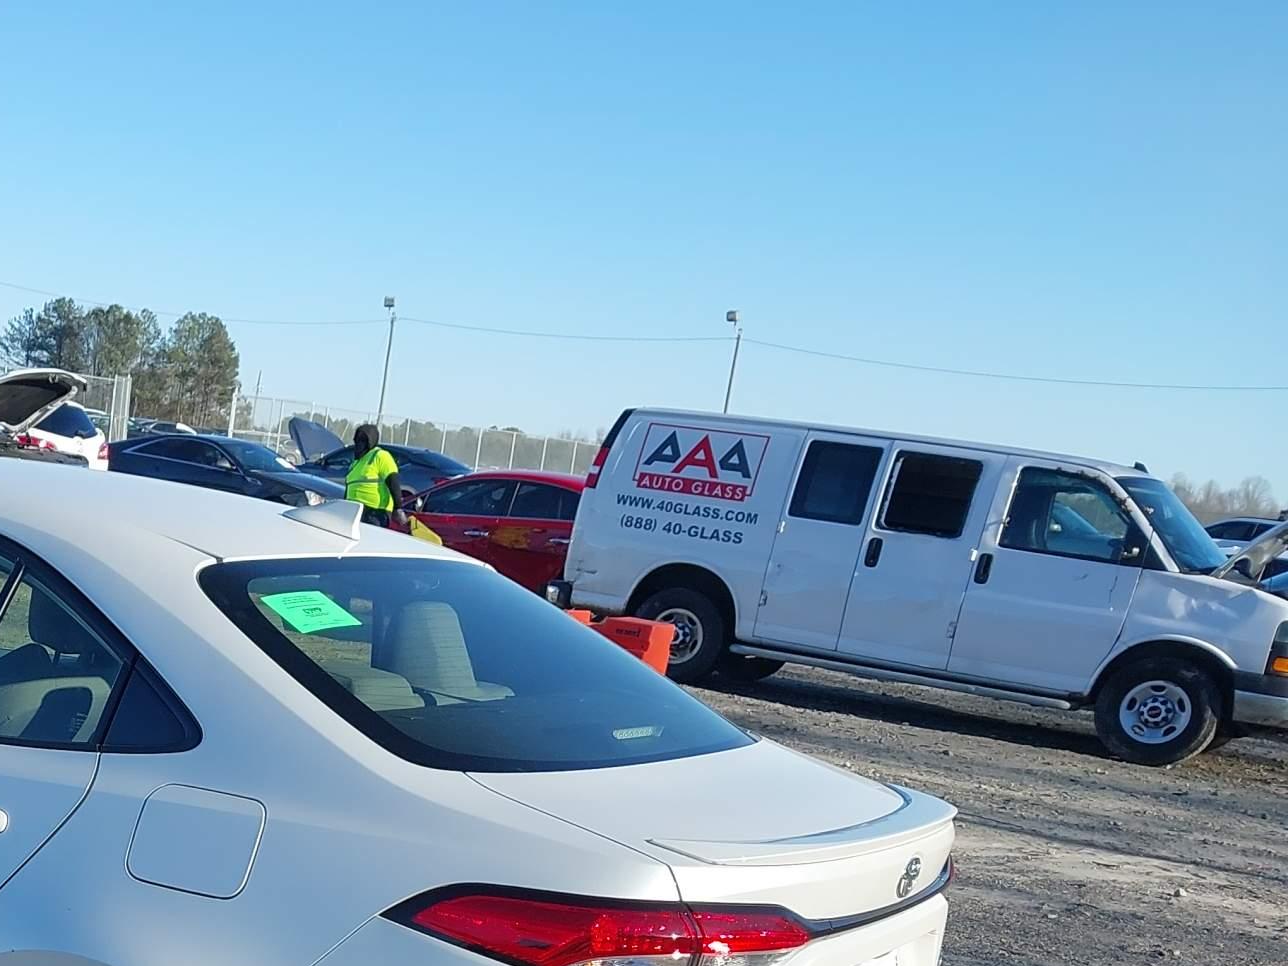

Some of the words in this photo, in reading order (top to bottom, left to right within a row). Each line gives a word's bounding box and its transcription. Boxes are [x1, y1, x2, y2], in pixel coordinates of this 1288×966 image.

[643, 430, 752, 479] AAA
[640, 476, 684, 491] AUTO
[691, 481, 745, 500] GLASS
[616, 493, 758, 525] WWW.40GLASS.COM
[620, 513, 657, 532] (888)
[662, 521, 744, 544] 40-GLASS
